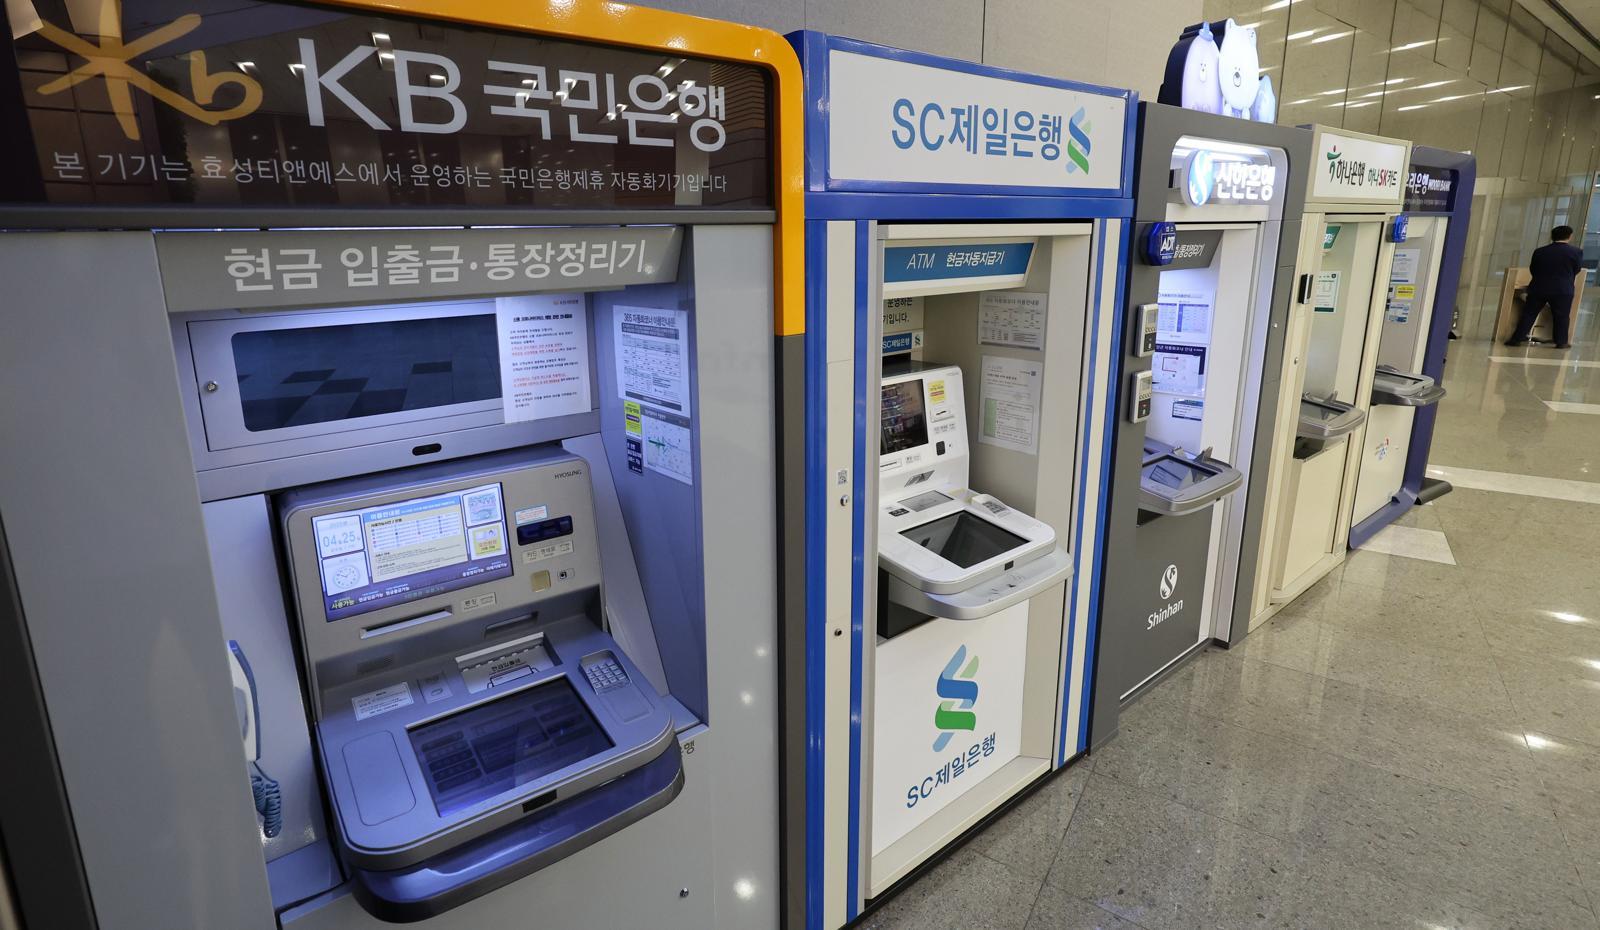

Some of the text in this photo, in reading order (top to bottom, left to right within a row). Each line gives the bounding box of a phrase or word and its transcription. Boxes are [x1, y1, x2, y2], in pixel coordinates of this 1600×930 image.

[299, 38, 727, 152] KB 국민은행
[891, 98, 1062, 161] SC제일은행
[53, 152, 727, 193] 본 기기는 효성티앤에스에서 운영하는 국민은행제휴 자동화기기입니다
[1215, 161, 1276, 202] 신한은행
[1336, 159, 1398, 188] 하나은행 하나SK카드
[907, 251, 1005, 270] ATM 현금자동지급기
[1160, 236, 1176, 253] ADT
[224, 239, 648, 292] 현금 입출금·통장정리기
[554, 469, 583, 480] HYOSUNG
[1147, 599, 1184, 630] Shinhan
[906, 732, 997, 809] SC제일은행
